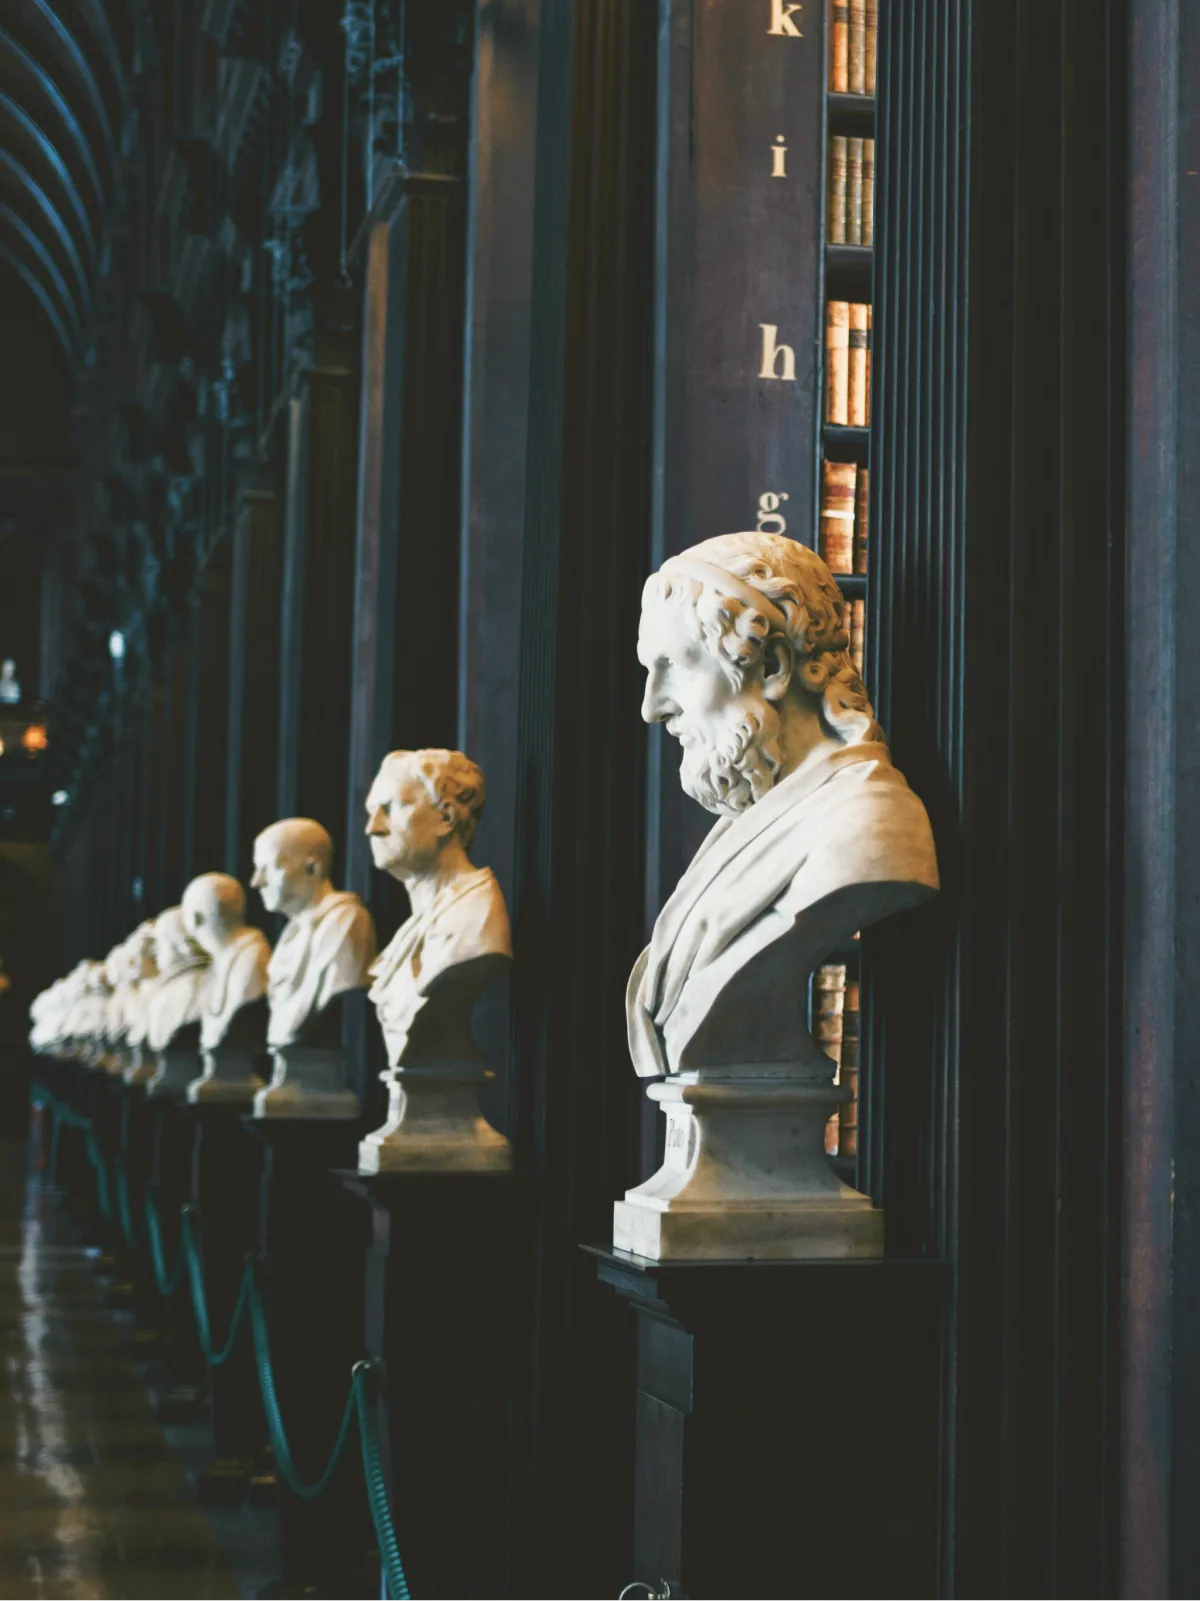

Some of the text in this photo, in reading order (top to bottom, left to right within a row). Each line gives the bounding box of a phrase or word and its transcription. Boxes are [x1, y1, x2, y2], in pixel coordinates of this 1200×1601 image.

[767, 0, 803, 38] k
[771, 134, 788, 178] i
[757, 323, 797, 381] h
[756, 491, 789, 536] g
